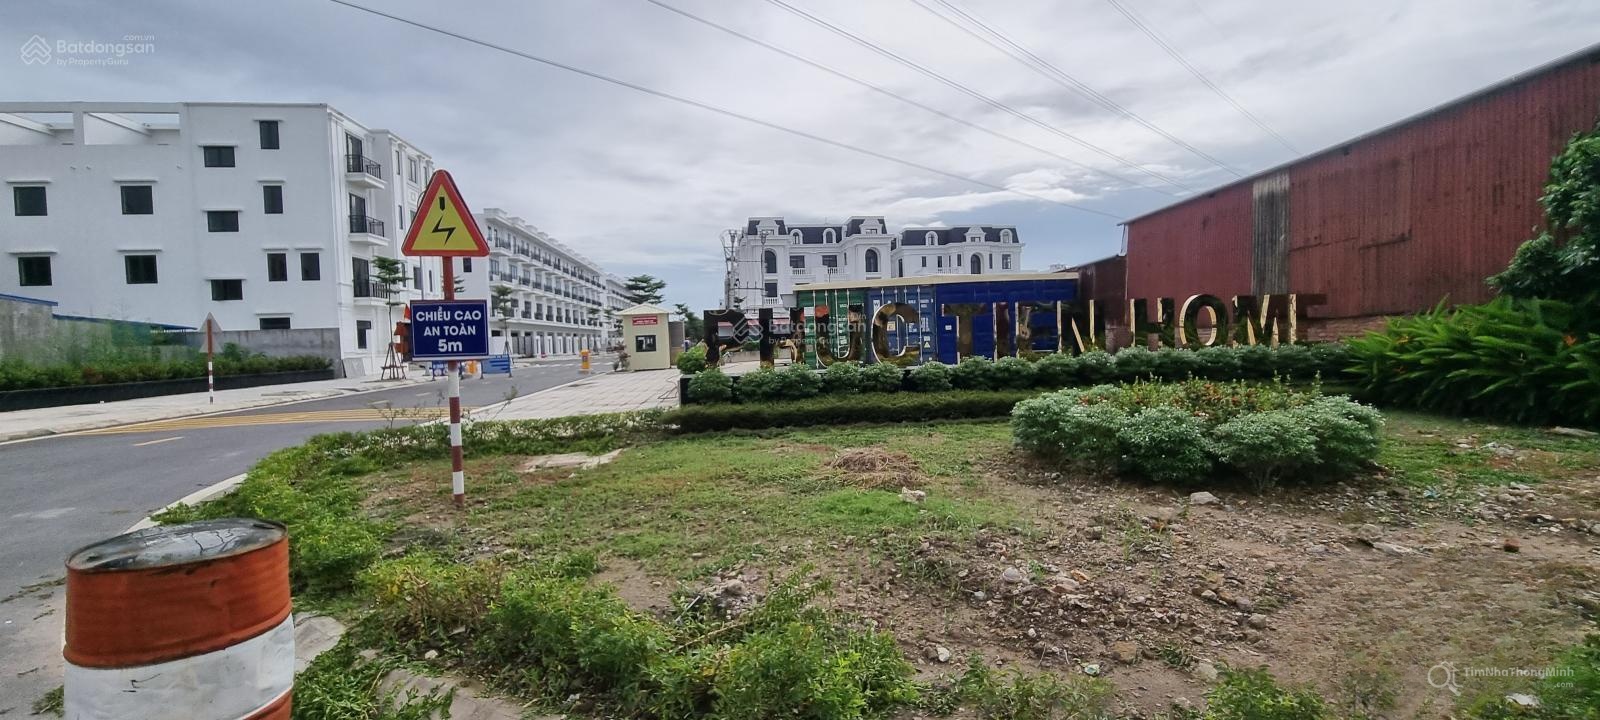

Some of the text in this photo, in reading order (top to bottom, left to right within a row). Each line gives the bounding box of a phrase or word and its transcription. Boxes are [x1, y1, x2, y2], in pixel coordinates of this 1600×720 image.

[454, 310, 482, 320] CAO
[423, 323, 476, 337] AN TOÀN
[437, 339, 463, 352] 5m
